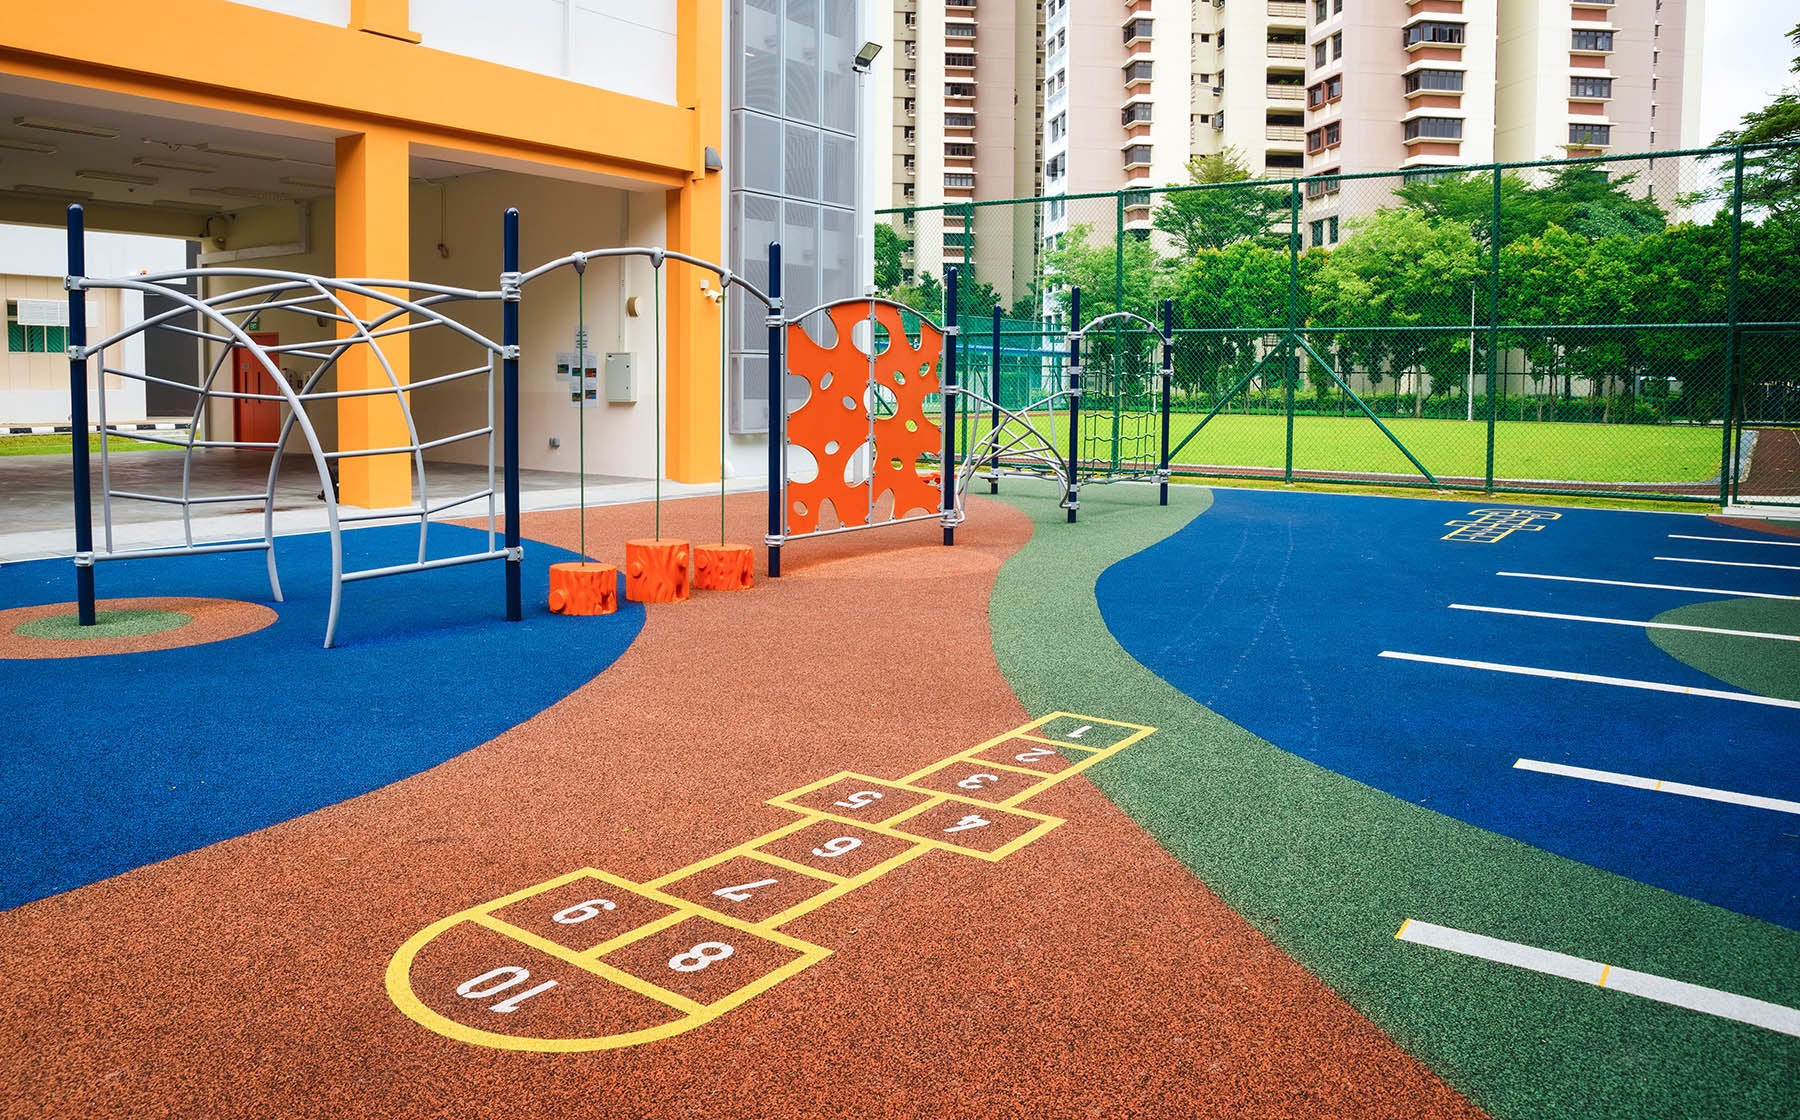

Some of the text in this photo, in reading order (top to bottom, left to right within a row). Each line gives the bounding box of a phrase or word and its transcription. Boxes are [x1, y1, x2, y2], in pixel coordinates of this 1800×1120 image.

[1066, 725, 1093, 738] 1
[1015, 747, 1056, 762] 2
[957, 773, 999, 789] 3
[834, 790, 884, 809] 5
[943, 814, 992, 833] 4
[811, 836, 862, 858] 6
[712, 878, 779, 902] 7
[552, 898, 617, 925] 9
[668, 941, 735, 973] 8
[456, 965, 559, 1014] 10
